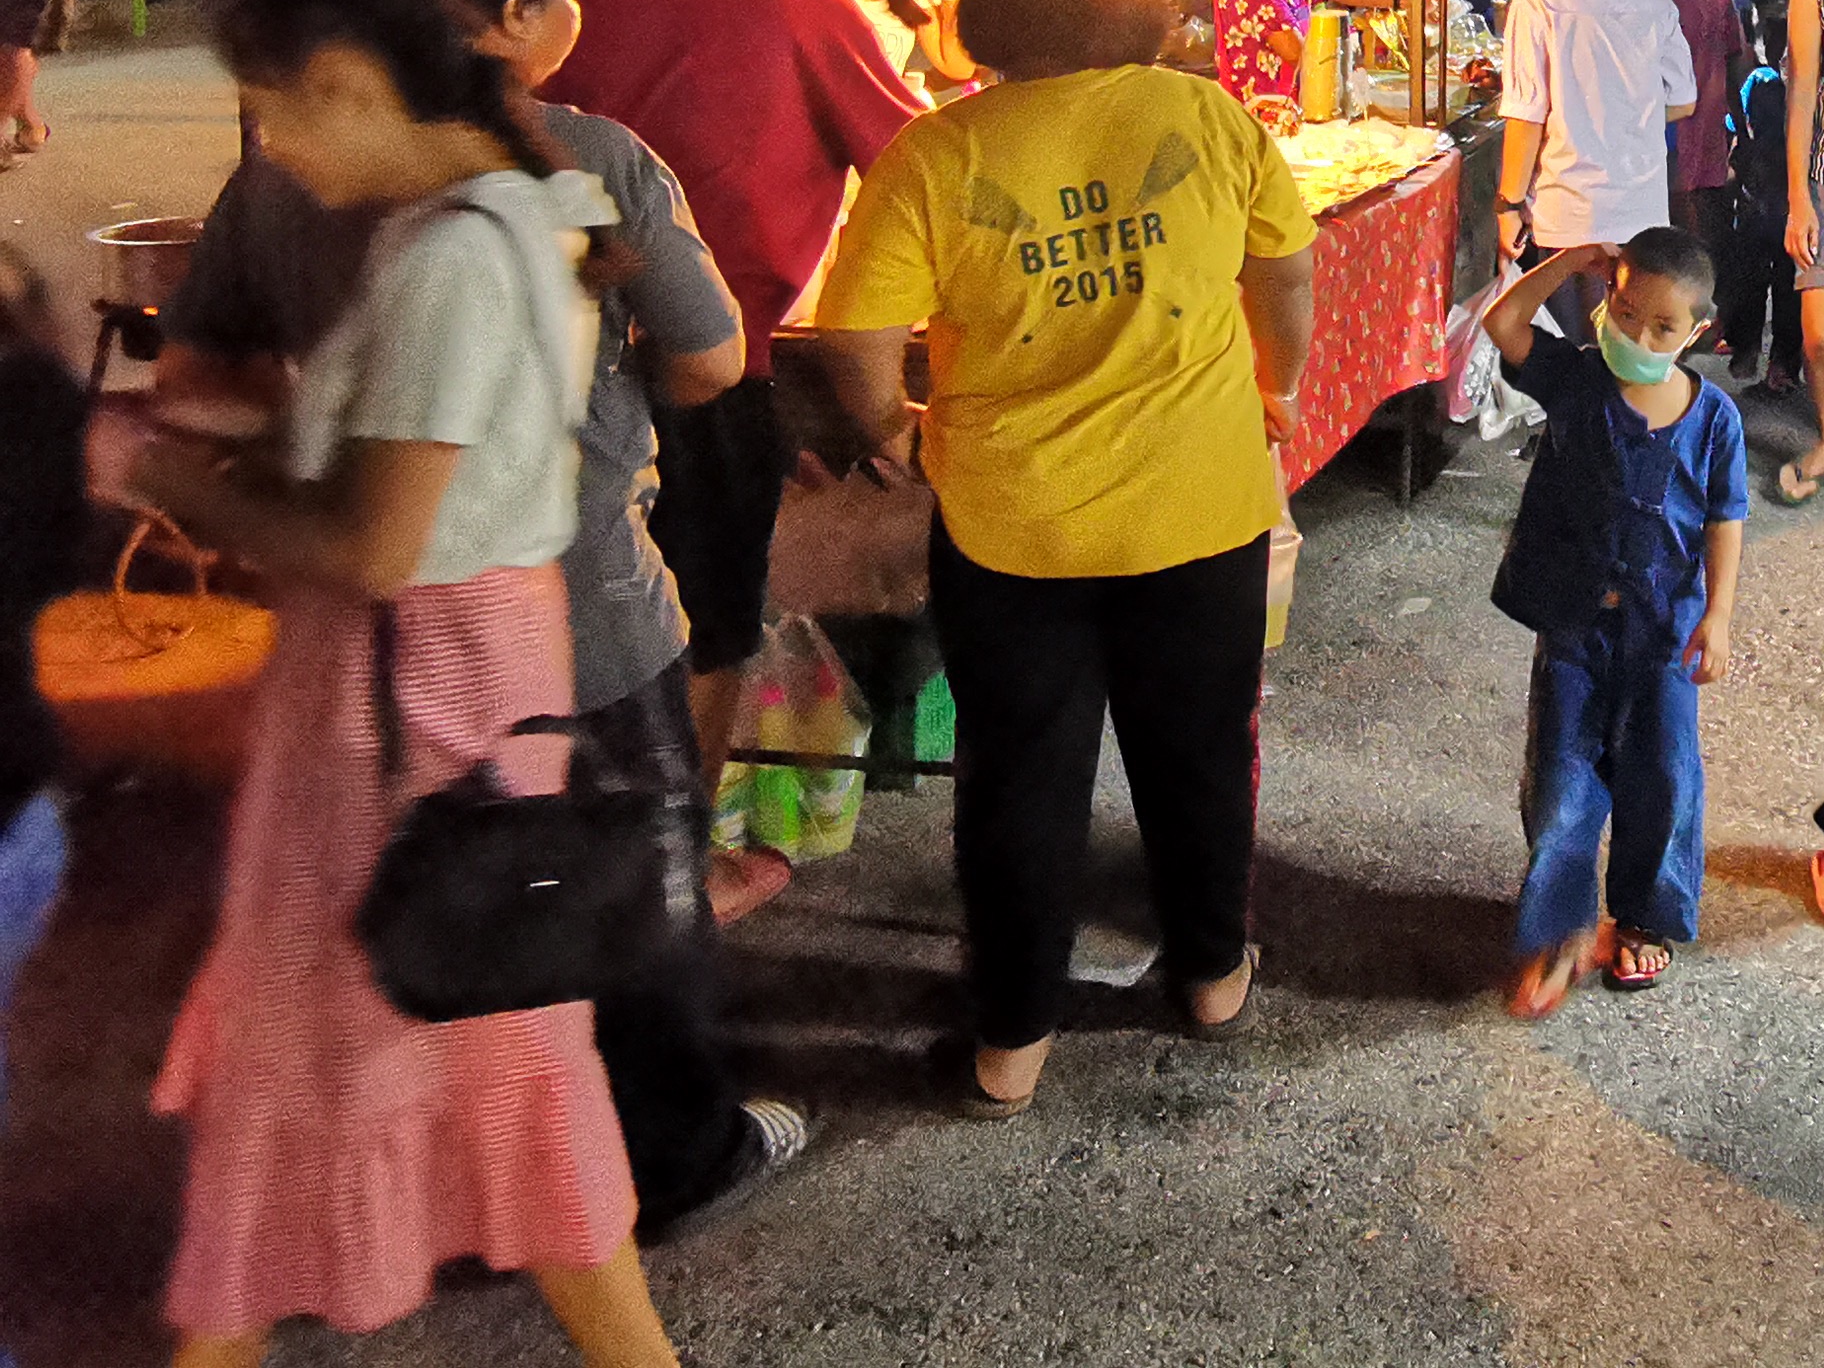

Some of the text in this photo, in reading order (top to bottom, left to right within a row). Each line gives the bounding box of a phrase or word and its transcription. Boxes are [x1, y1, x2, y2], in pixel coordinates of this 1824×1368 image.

[1059, 179, 1109, 221] DO
[1019, 212, 1167, 275] BETTER
[1053, 261, 1145, 309] 2015
